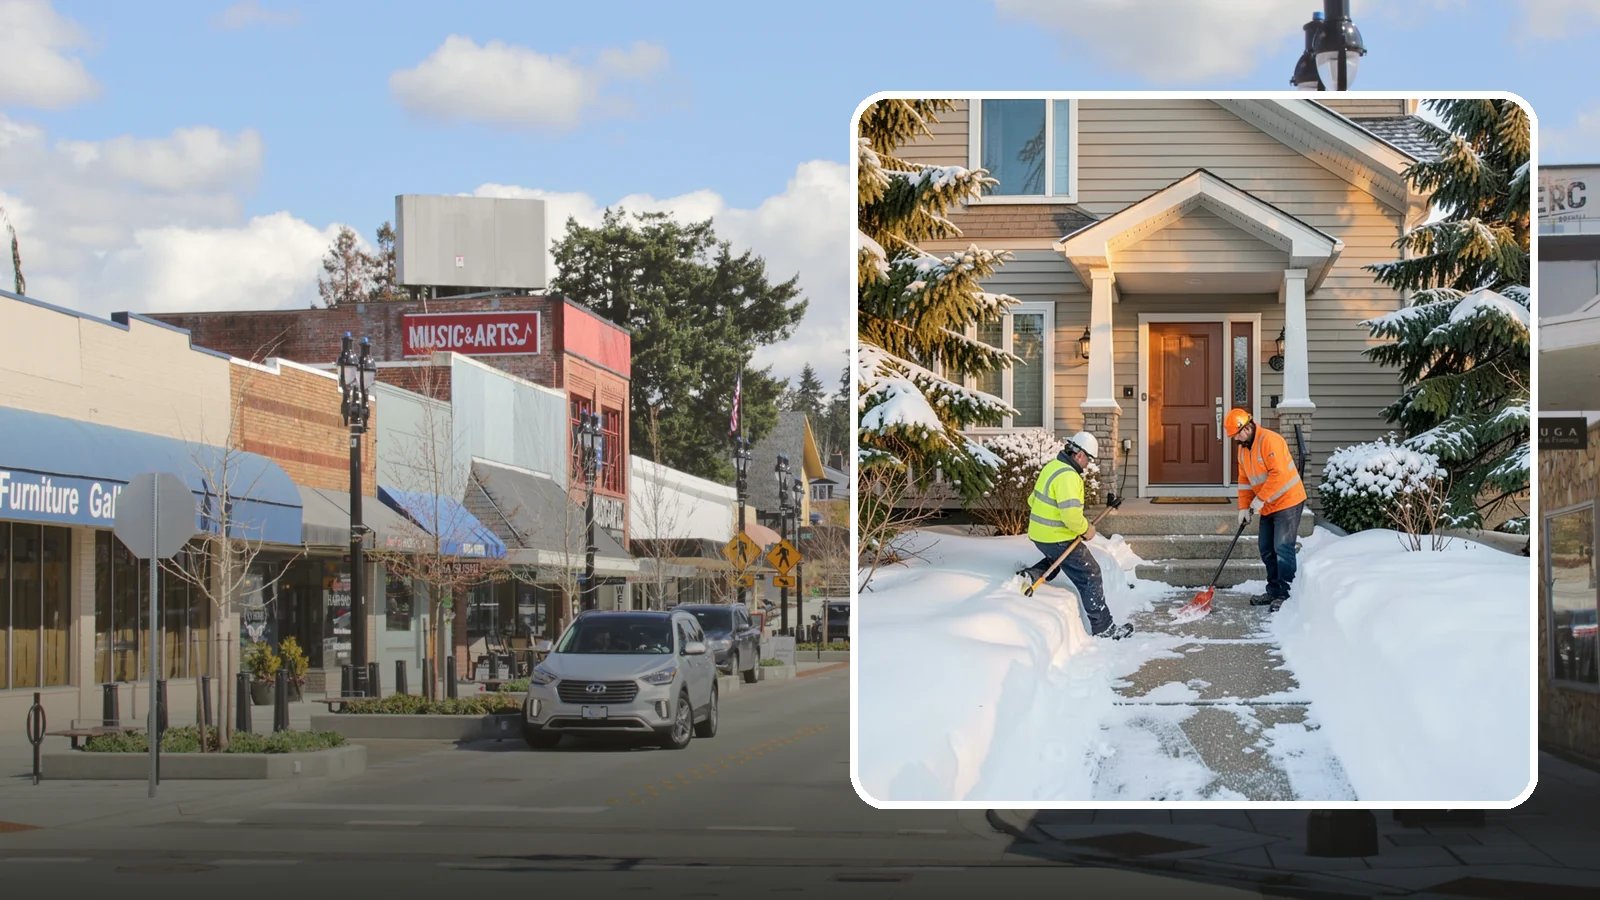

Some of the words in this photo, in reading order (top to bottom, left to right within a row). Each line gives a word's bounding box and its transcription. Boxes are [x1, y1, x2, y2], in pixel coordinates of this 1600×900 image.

[409, 323, 519, 349] MUSIC&ARTS
[1540, 427, 1577, 436] UGA
[1552, 436, 1579, 444] Framing
[0, 471, 79, 516] Furniture
[453, 563, 479, 574] SUSHI
